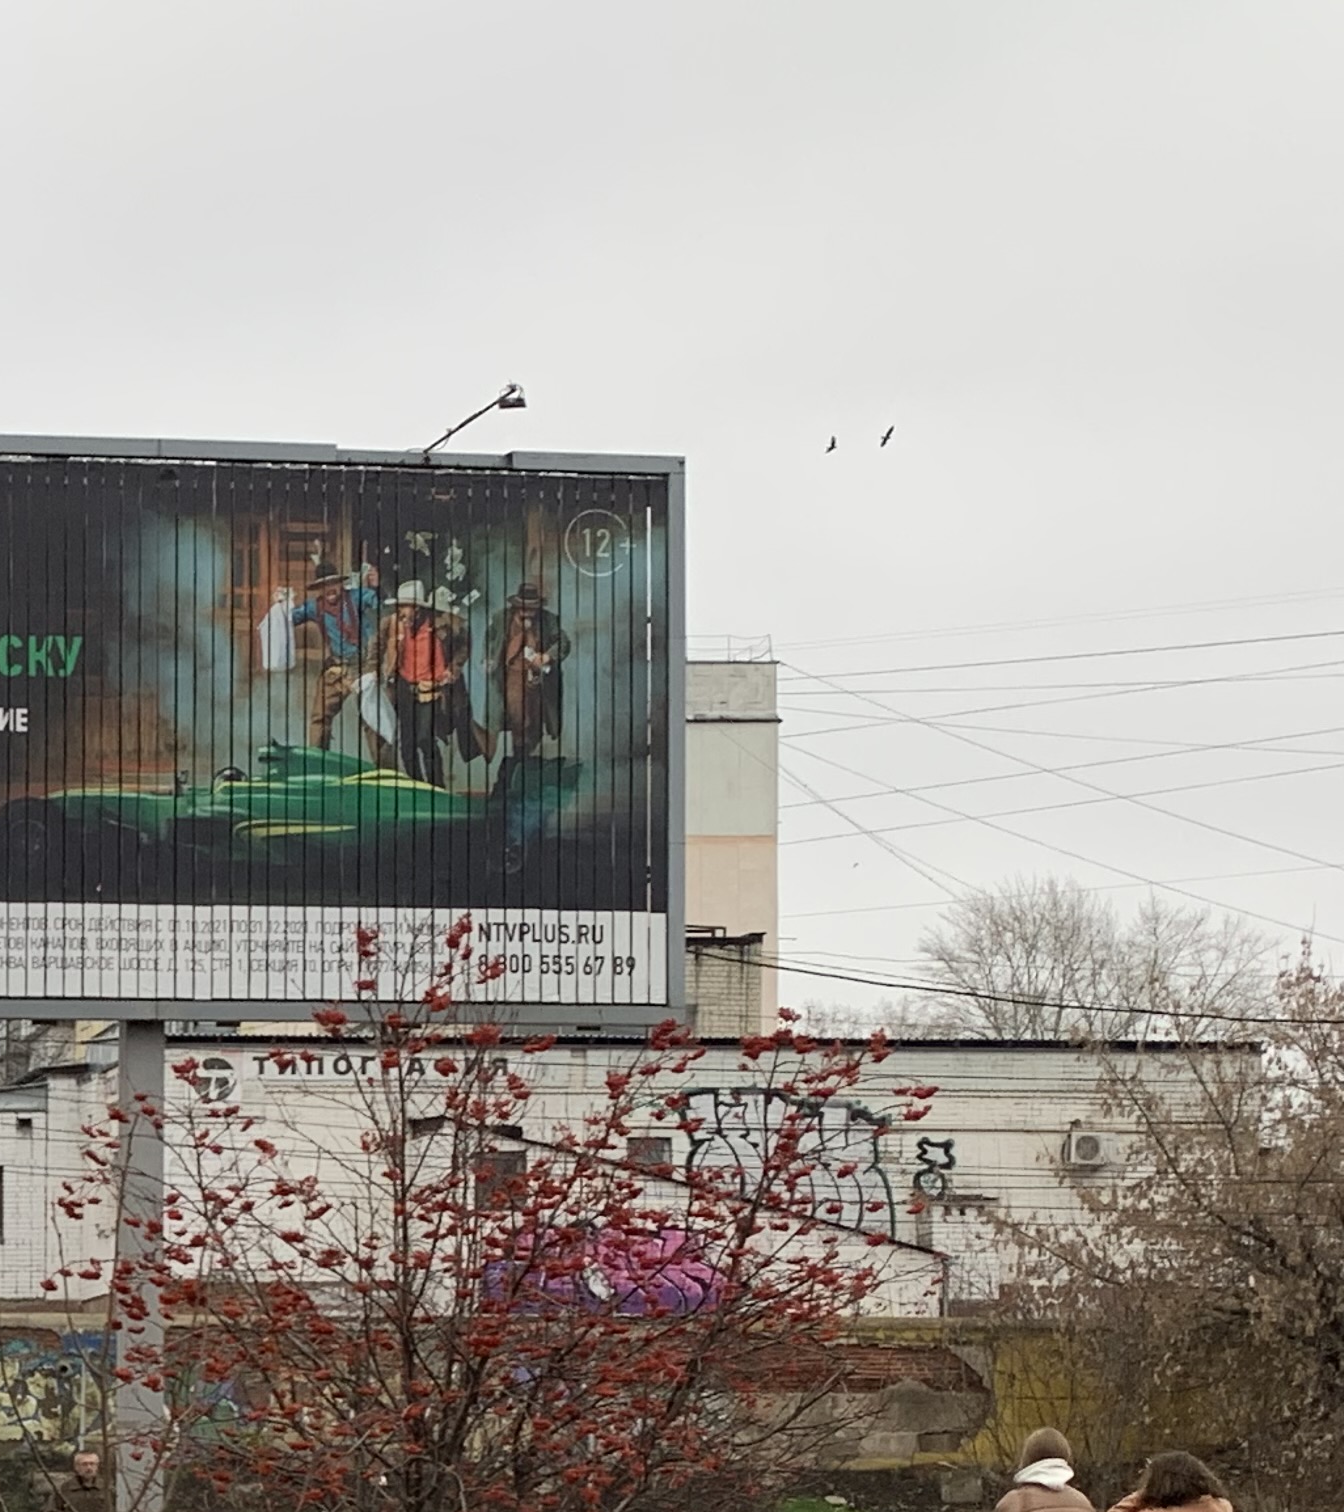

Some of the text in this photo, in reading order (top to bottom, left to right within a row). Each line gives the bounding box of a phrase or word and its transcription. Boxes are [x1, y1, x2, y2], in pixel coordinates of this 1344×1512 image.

[581, 527, 638, 558] 12+
[477, 922, 605, 945] NTVPLUS.RU
[540, 956, 576, 976] 555
[582, 956, 605, 976] 67
[612, 956, 637, 977] 89
